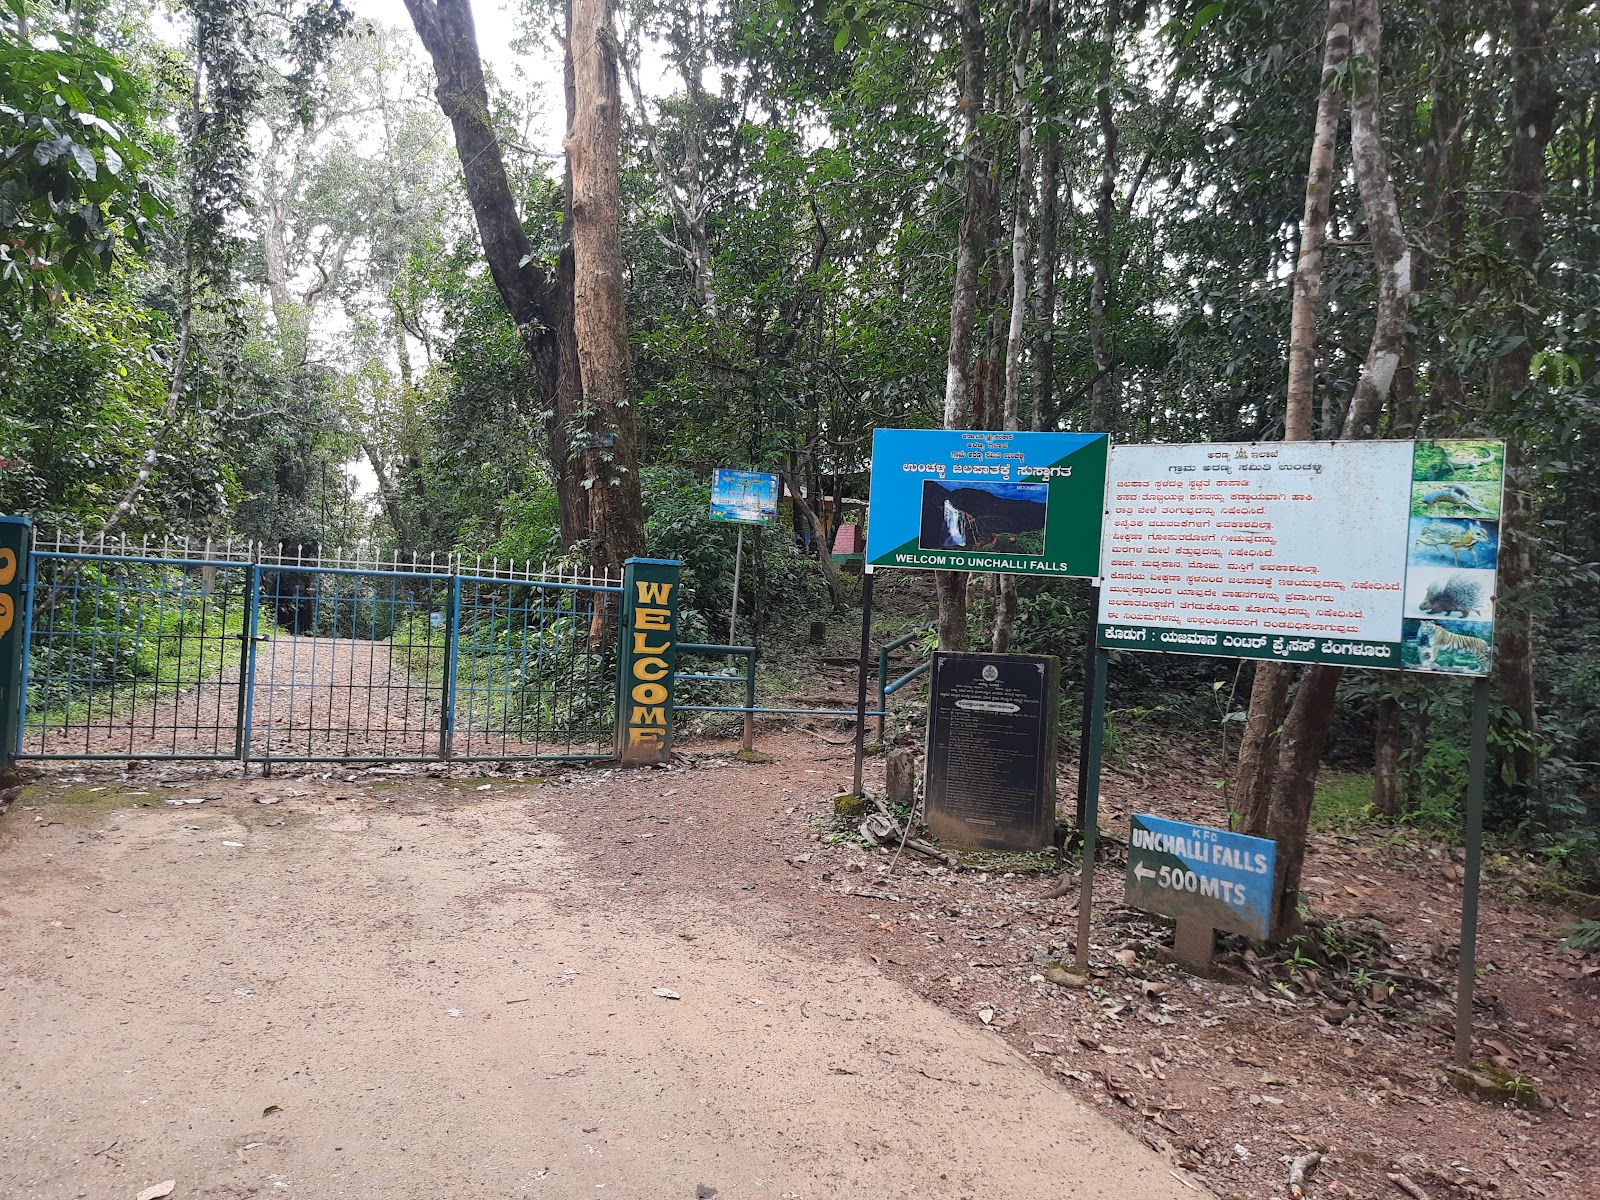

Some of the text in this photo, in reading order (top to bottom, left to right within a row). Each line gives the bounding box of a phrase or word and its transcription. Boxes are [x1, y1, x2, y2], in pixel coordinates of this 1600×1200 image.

[953, 463, 1011, 480] ಜಲಪಾತಕ್ಕೆ
[1017, 465, 1072, 481] ಸುಸ್ವಾಗತ
[895, 554, 1068, 571] WELCOM TO UNCHALLI FALLS
[1105, 626, 1146, 641] ಕೊಡುಗೆ
[1161, 630, 1218, 646] ಯಜಮಾನ
[628, 581, 673, 750] WELCOME
[1192, 828, 1217, 842] KFD
[1132, 828, 1268, 874] UNCHALLI FALLS
[1157, 865, 1246, 906] 500 MTS
